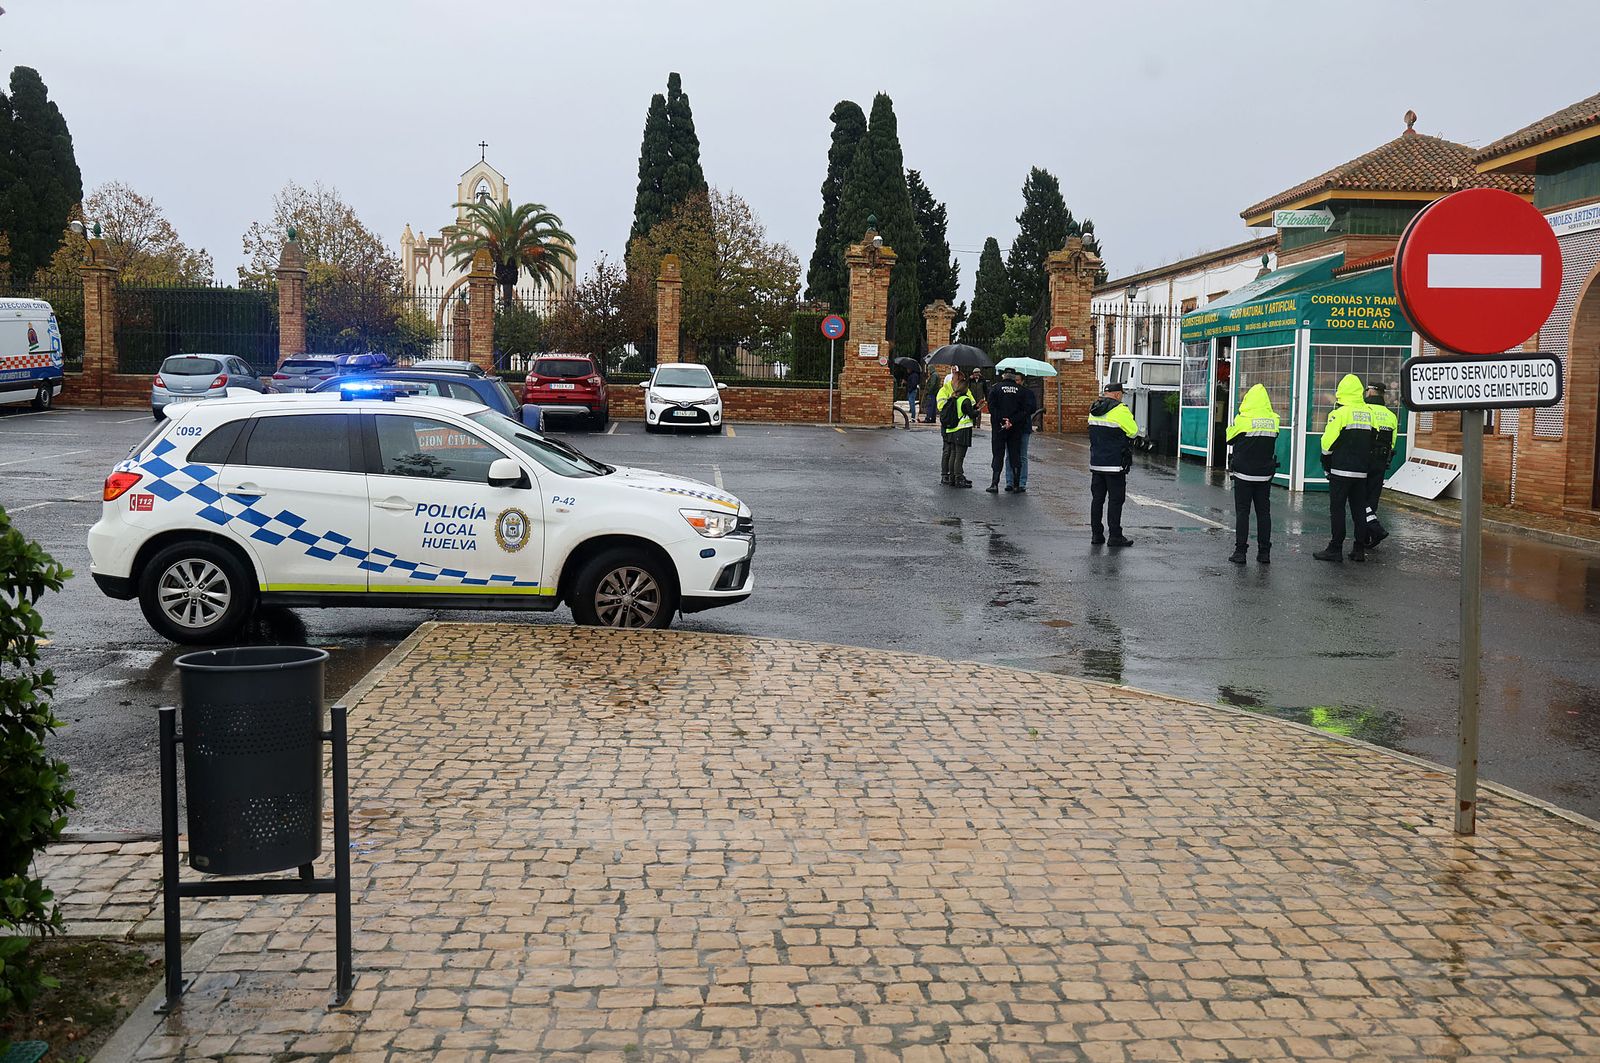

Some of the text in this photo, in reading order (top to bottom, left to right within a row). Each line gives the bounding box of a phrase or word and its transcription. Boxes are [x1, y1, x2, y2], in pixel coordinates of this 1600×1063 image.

[1311, 295, 1397, 305] CORONAS Y RAM
[1331, 307, 1391, 318] 24 HORAS
[1326, 318, 1395, 329] TODO EL AÑO
[1412, 363, 1554, 381] EXCEPTO SERVICIO PUBLICO
[1418, 381, 1549, 400] Y SERVICIOS CEMENTERIO
[181, 426, 202, 436] 092
[551, 495, 576, 506] P-42
[415, 503, 487, 520] POLICÍA
[424, 522, 477, 536] LOCAL
[422, 537, 477, 550] HUELVA
